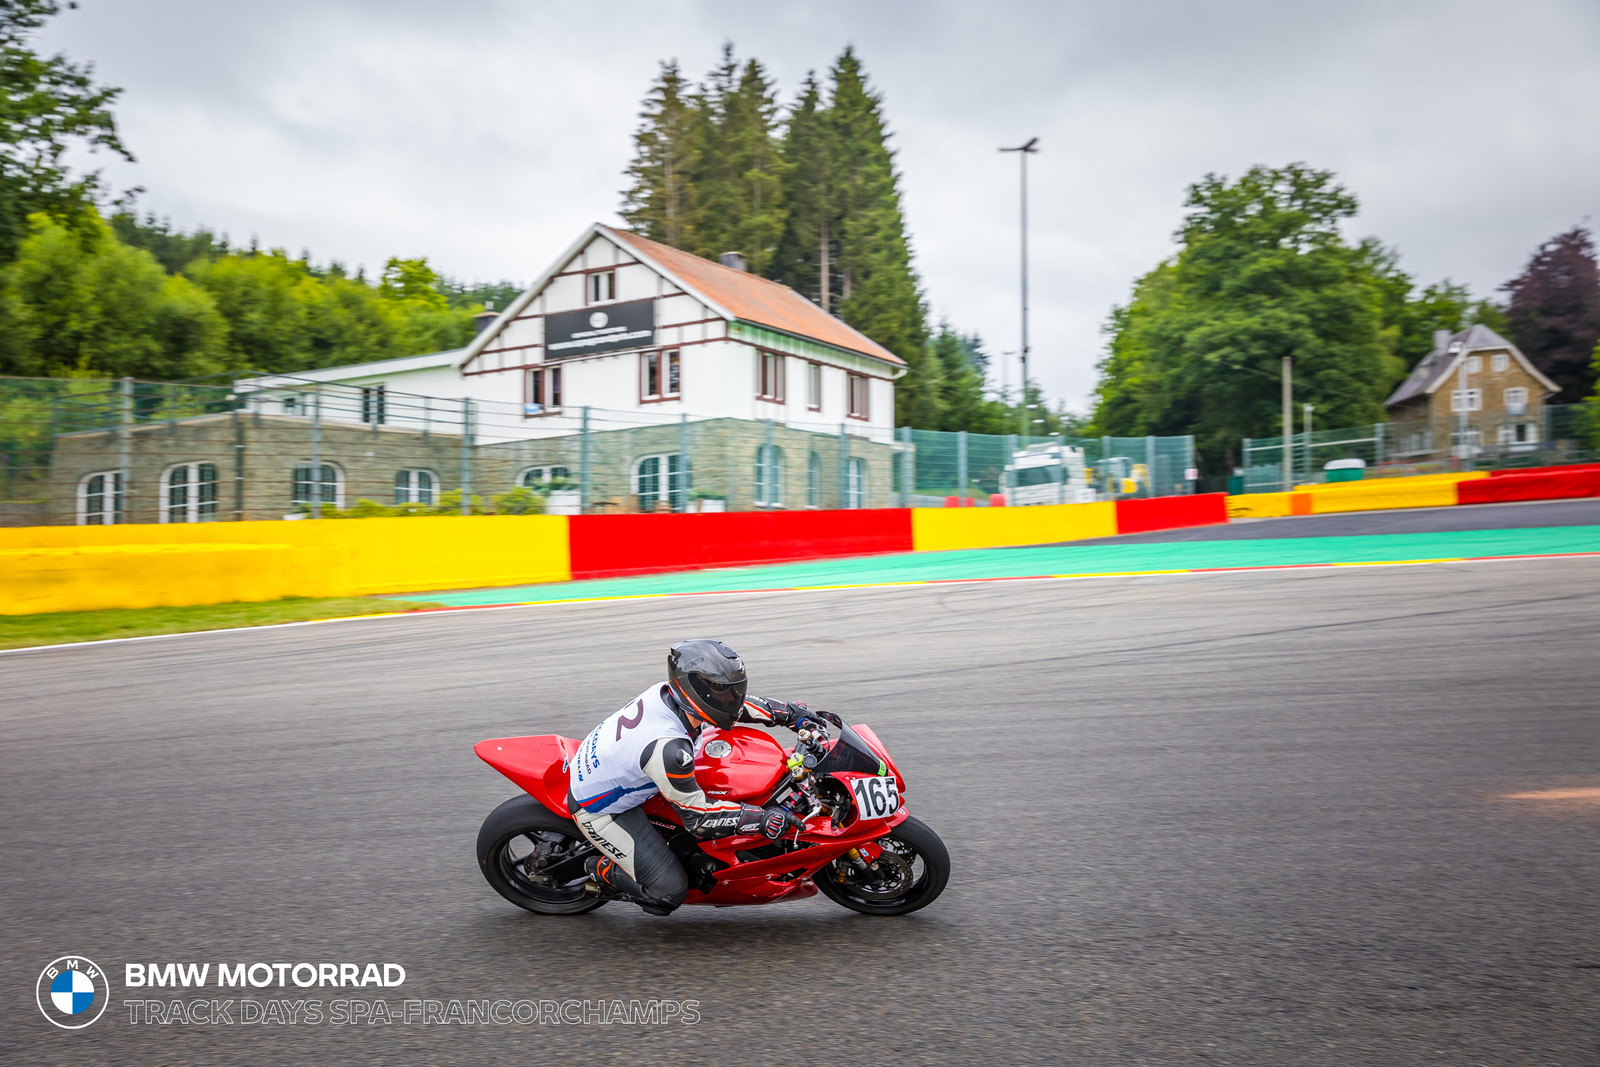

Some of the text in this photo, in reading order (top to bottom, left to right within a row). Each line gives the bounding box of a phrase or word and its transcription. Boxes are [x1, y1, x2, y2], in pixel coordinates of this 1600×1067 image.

[854, 777, 900, 818] 165
[581, 821, 628, 860] DAINESE
[701, 816, 740, 829] DAINES
